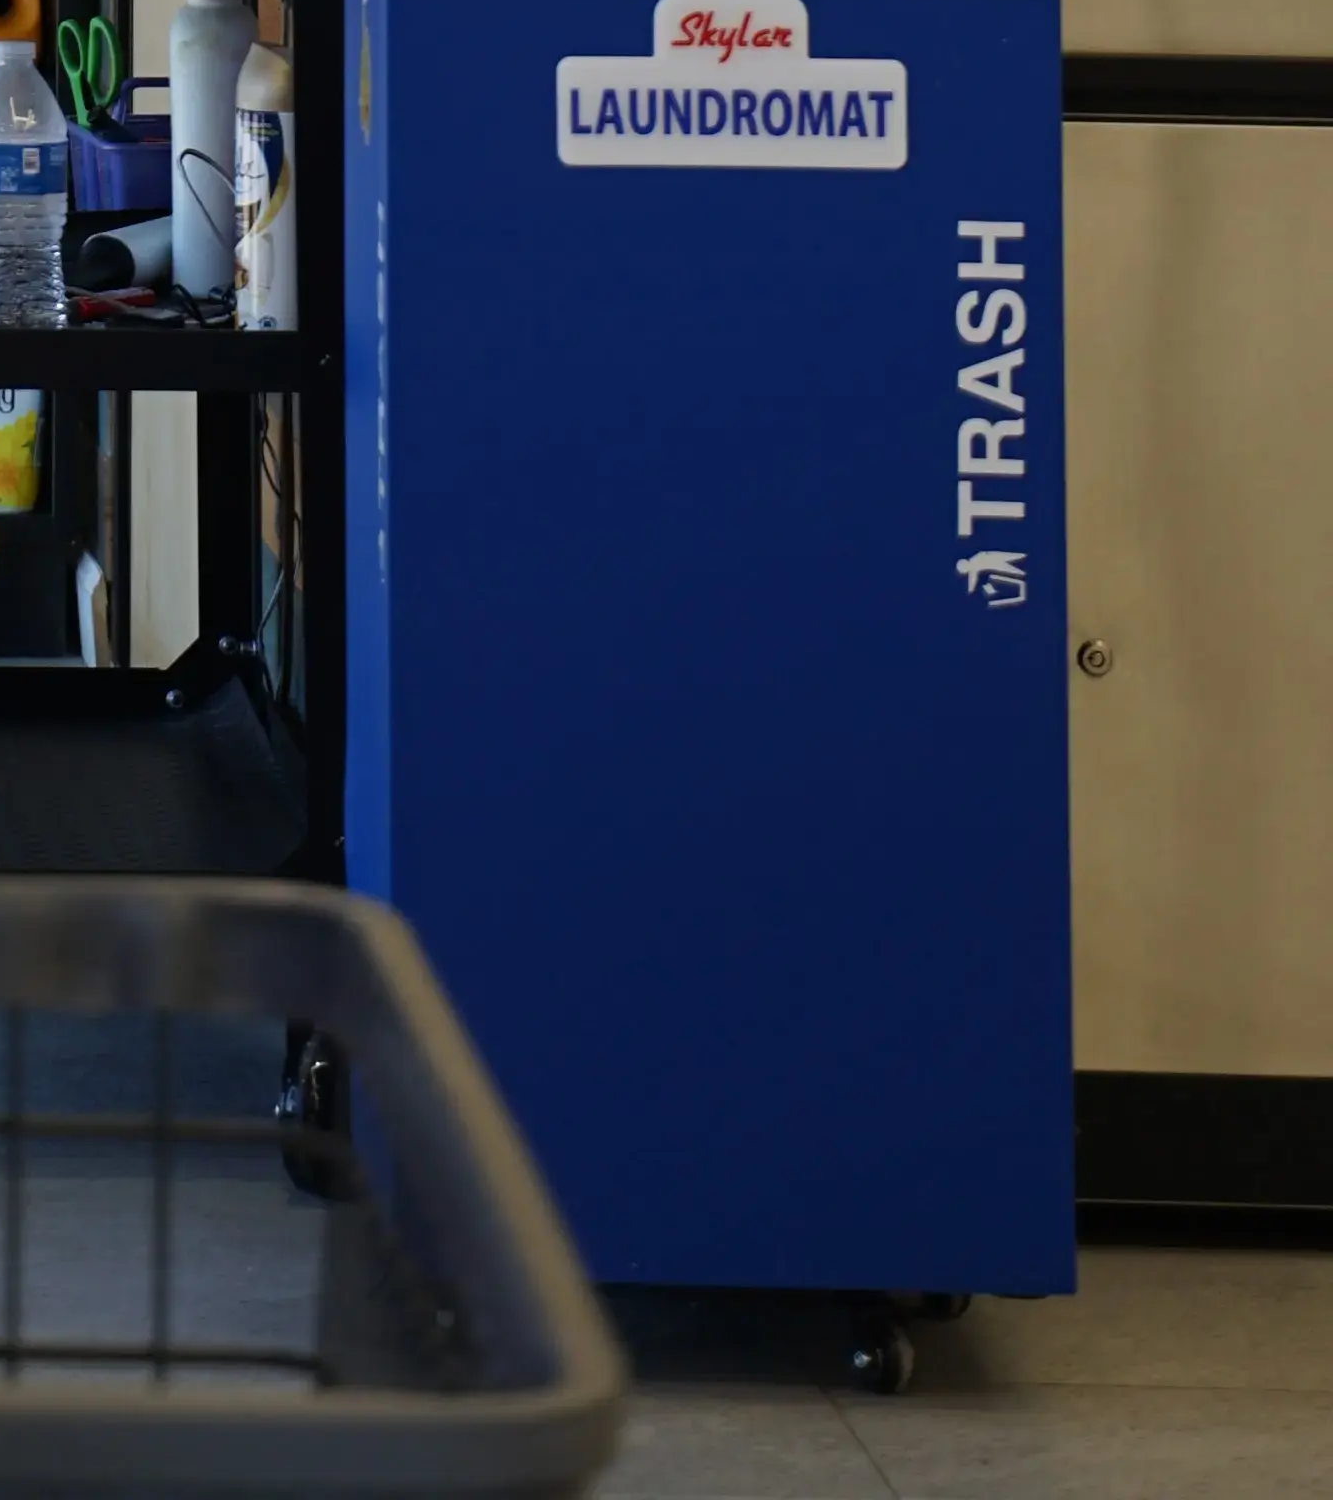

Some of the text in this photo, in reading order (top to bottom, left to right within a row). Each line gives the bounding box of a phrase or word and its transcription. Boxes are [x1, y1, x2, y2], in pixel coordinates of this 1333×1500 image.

[671, 11, 791, 63] Skylar
[569, 88, 894, 138] LAUNDROMAT
[956, 220, 1026, 537] TRASH
